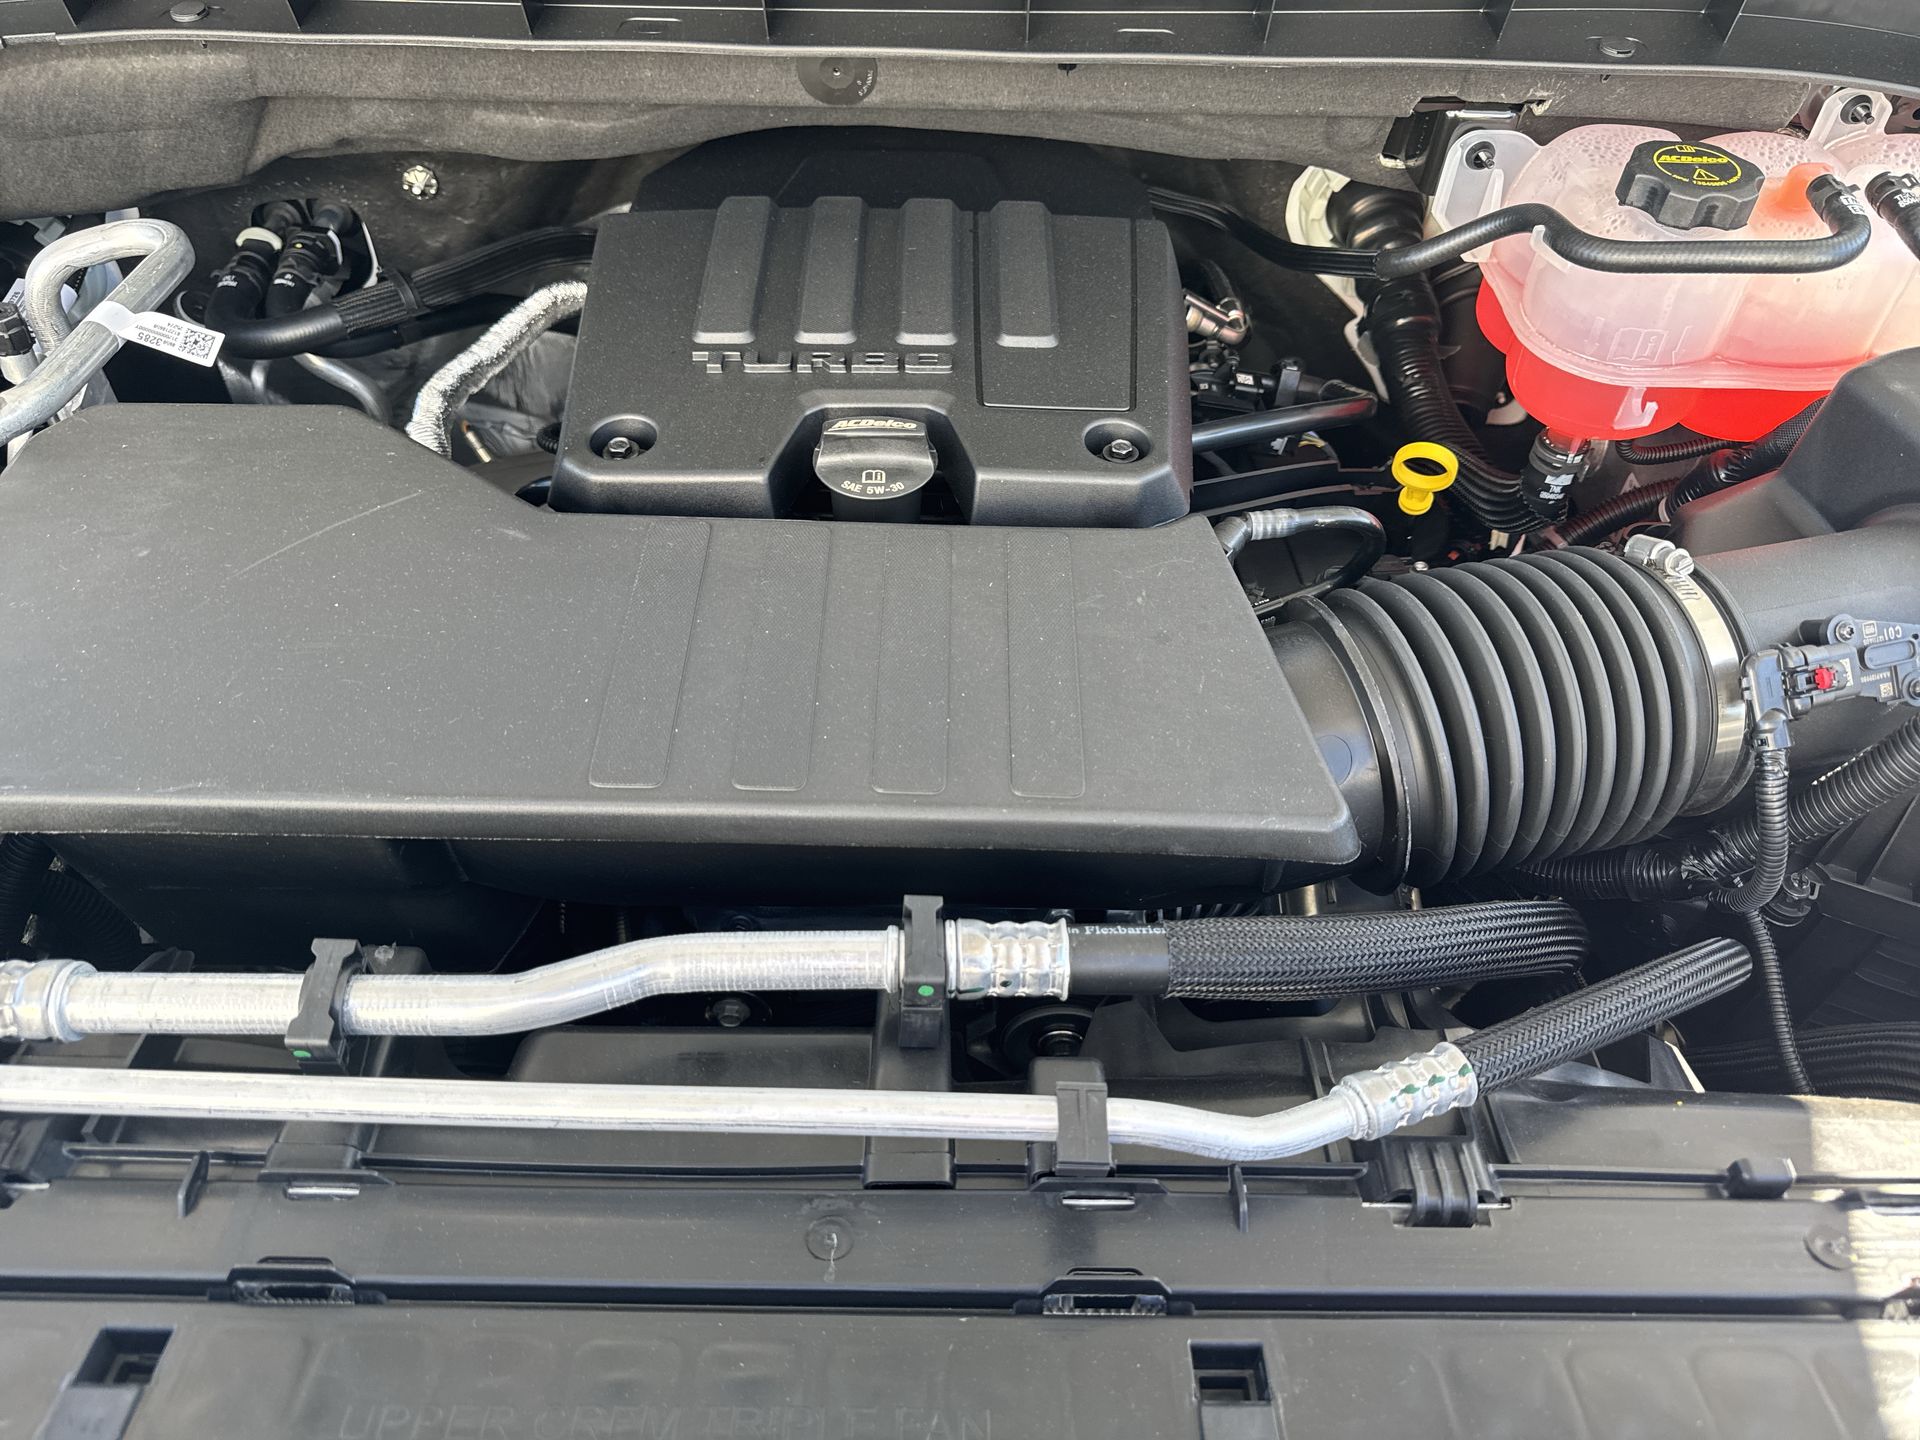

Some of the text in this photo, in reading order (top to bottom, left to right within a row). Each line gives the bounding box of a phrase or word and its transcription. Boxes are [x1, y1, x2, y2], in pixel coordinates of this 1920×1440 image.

[136, 332, 163, 346] 3285
[692, 351, 952, 374] TURBO
[830, 419, 917, 429] ACDelco
[841, 480, 905, 494] SAE 5W-30
[339, 1404, 514, 1440] UPPER
[895, 1404, 992, 1440] FAN
